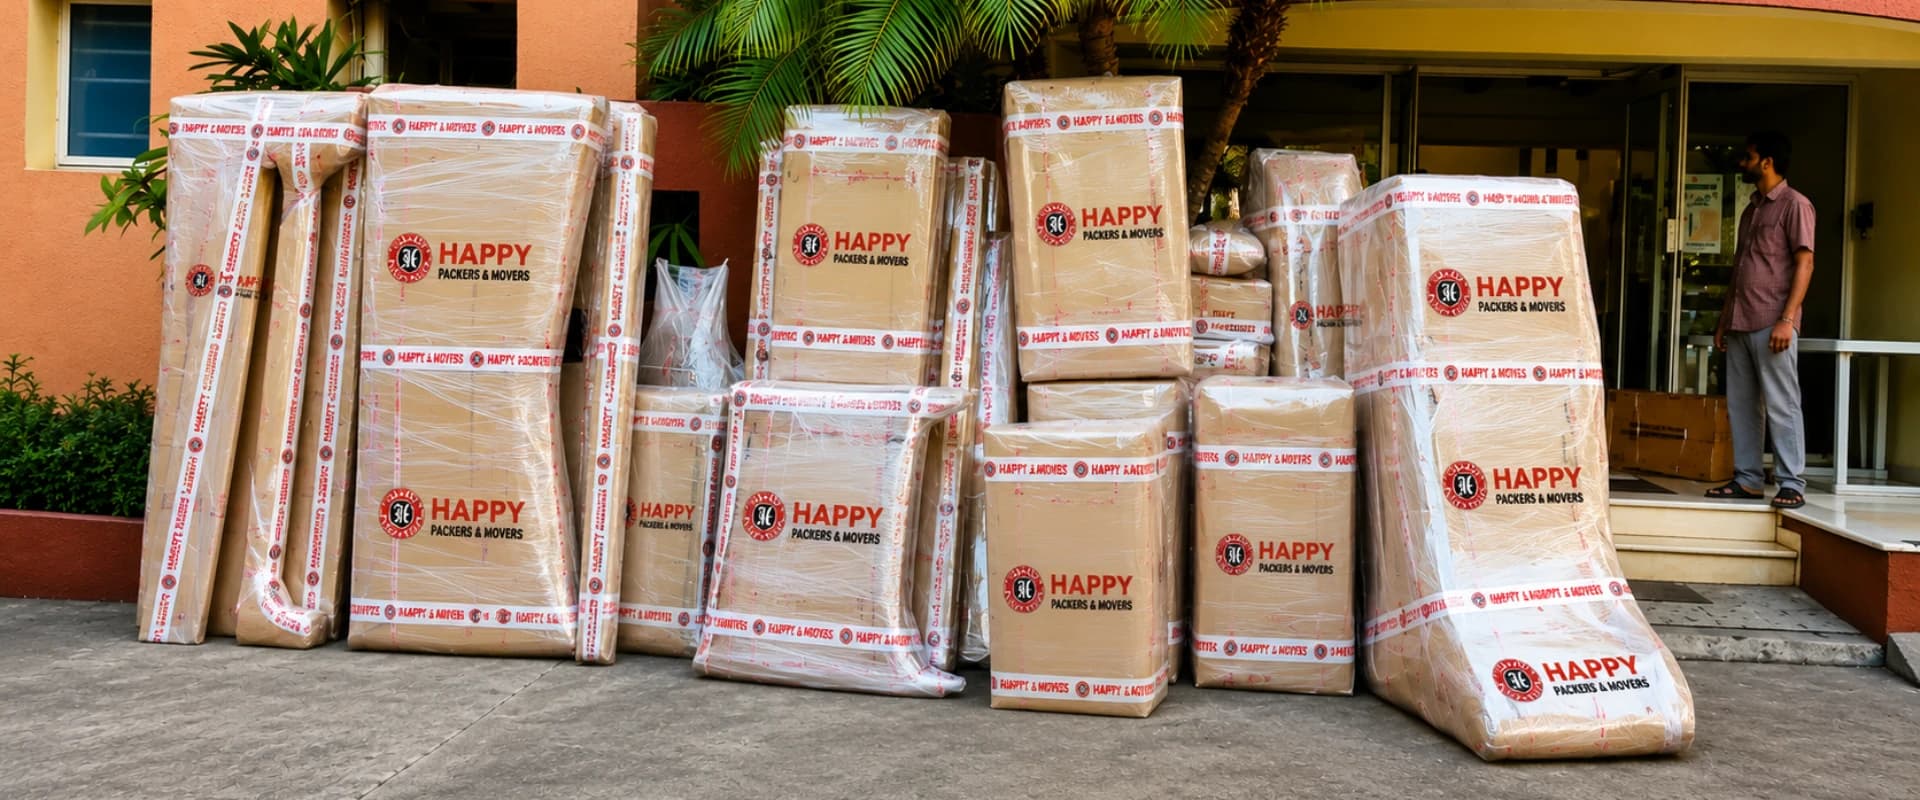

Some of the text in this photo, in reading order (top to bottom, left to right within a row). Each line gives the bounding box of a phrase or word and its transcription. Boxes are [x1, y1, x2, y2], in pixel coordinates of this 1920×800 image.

[1081, 205, 1163, 227] HAPPY
[834, 231, 911, 252] HAPPY
[1083, 227, 1163, 240] PACKERS & MOVERS
[439, 242, 532, 266] HAPPY
[833, 254, 909, 267] PACKERS & MOVERS
[438, 268, 530, 281] PACKERS & MOVERS
[1476, 276, 1564, 297] HAPPY
[1478, 301, 1566, 312] PACKERS & MOVERS
[1493, 467, 1582, 490] HAPPY
[1495, 491, 1583, 504] PACKERS & MOVERS
[431, 498, 525, 523] HAPPY
[641, 502, 695, 521] HAPPY
[793, 502, 883, 529] HAPPY
[430, 525, 524, 540] PACKERS & MOVERS
[792, 528, 880, 545] PACKERS & MOVERS
[1259, 541, 1334, 561] HAPPY
[1258, 563, 1334, 575] PACKERS & MOVERS
[1051, 574, 1133, 596] HAPPY
[1051, 599, 1133, 611] PACKERS & MOVERS
[1542, 655, 1637, 682] HAPPY
[1553, 678, 1650, 696] PACKERS & MOVERS
